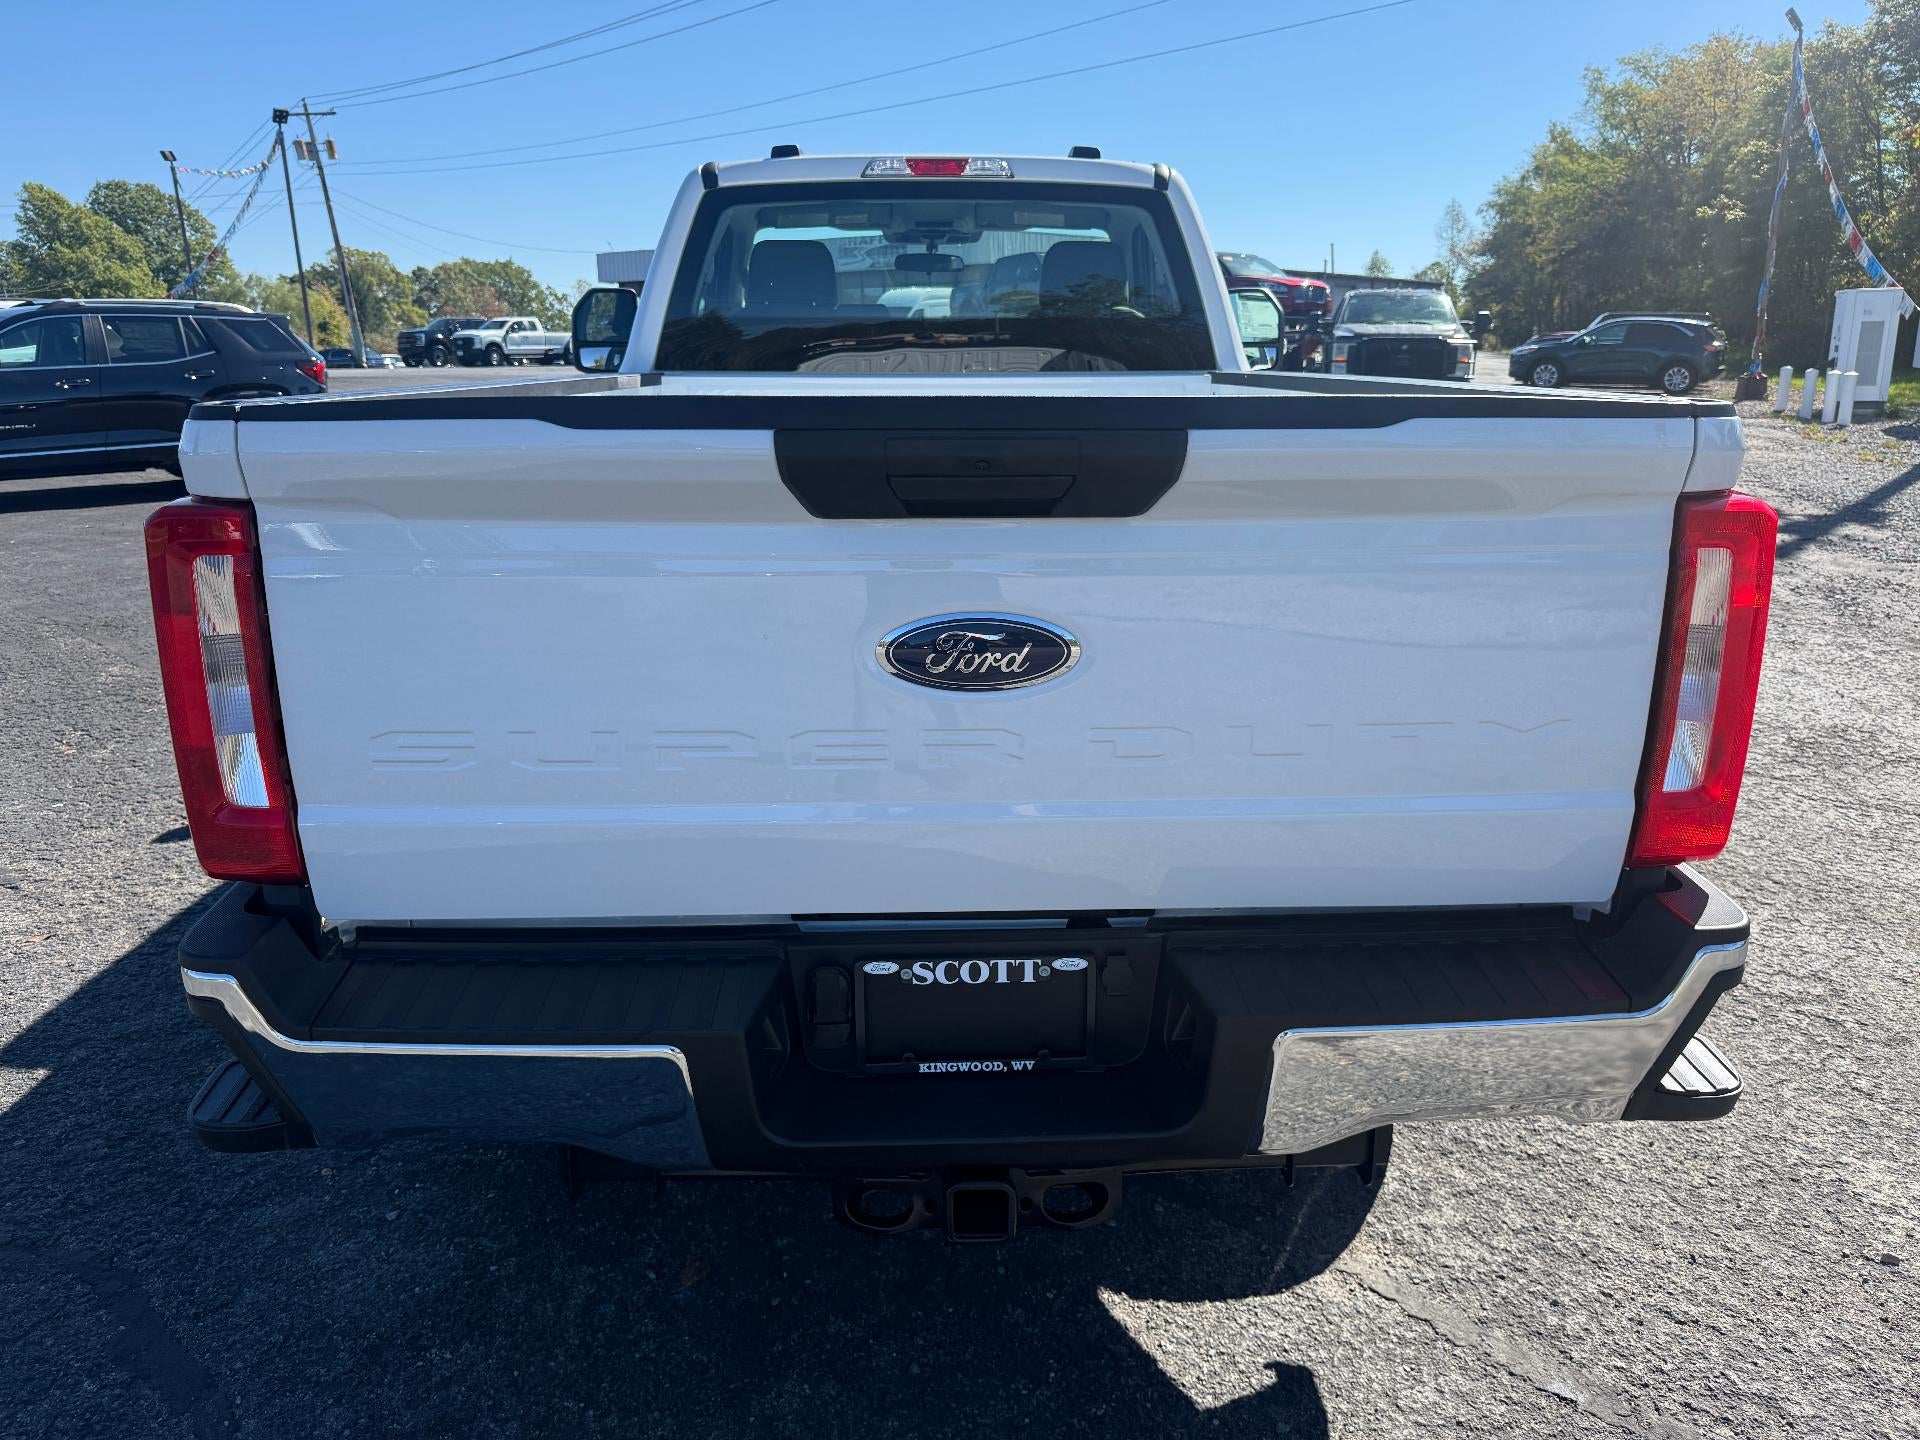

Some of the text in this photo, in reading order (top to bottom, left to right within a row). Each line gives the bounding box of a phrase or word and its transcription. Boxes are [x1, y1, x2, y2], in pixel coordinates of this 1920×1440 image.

[925, 630, 1032, 674] Ford
[368, 718, 1574, 772] SUPER DUTY
[912, 959, 1042, 985] SCOTT
[919, 1060, 1036, 1073] KINGWOOD, WV
